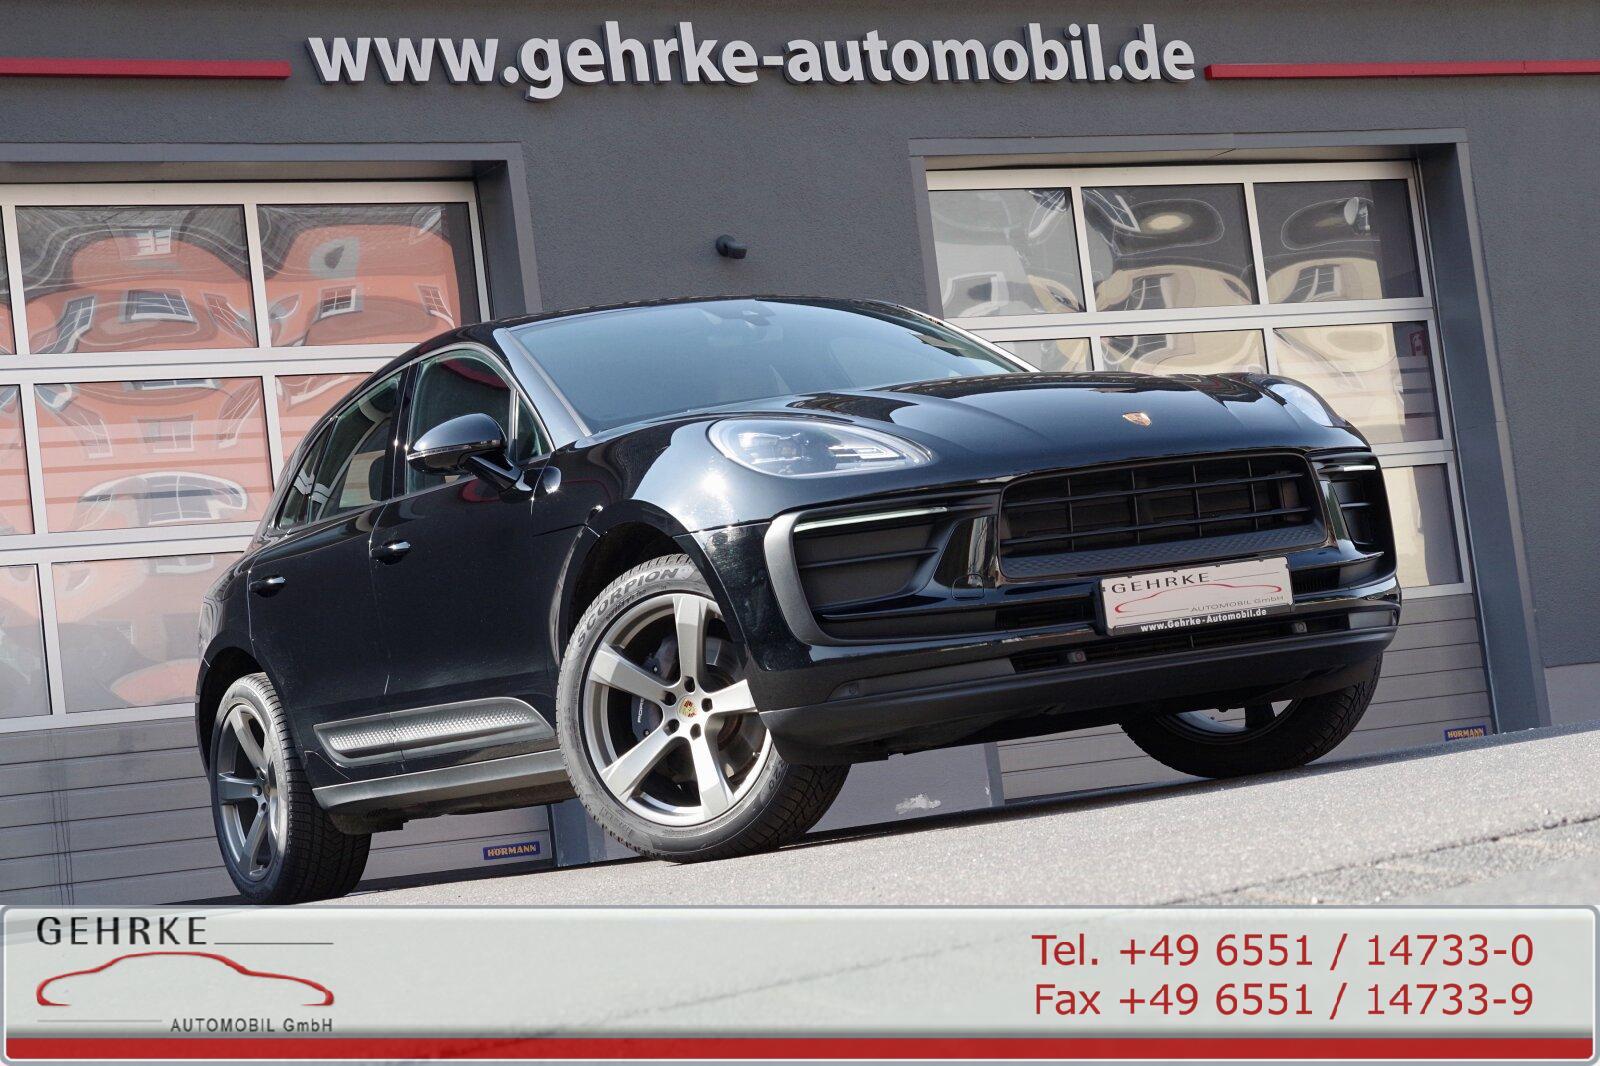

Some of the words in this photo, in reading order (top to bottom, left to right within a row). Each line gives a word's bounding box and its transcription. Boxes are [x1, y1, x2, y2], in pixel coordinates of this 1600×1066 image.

[307, 20, 1196, 102] www.gehrke-automobil.de
[1111, 572, 1211, 594] GEHRKE
[577, 567, 679, 648] SCORPION
[1190, 600, 1250, 613] AUTOMOBIL
[1253, 595, 1285, 605] GmbH
[1140, 608, 1268, 633] www.Gehrke-Automobil.de
